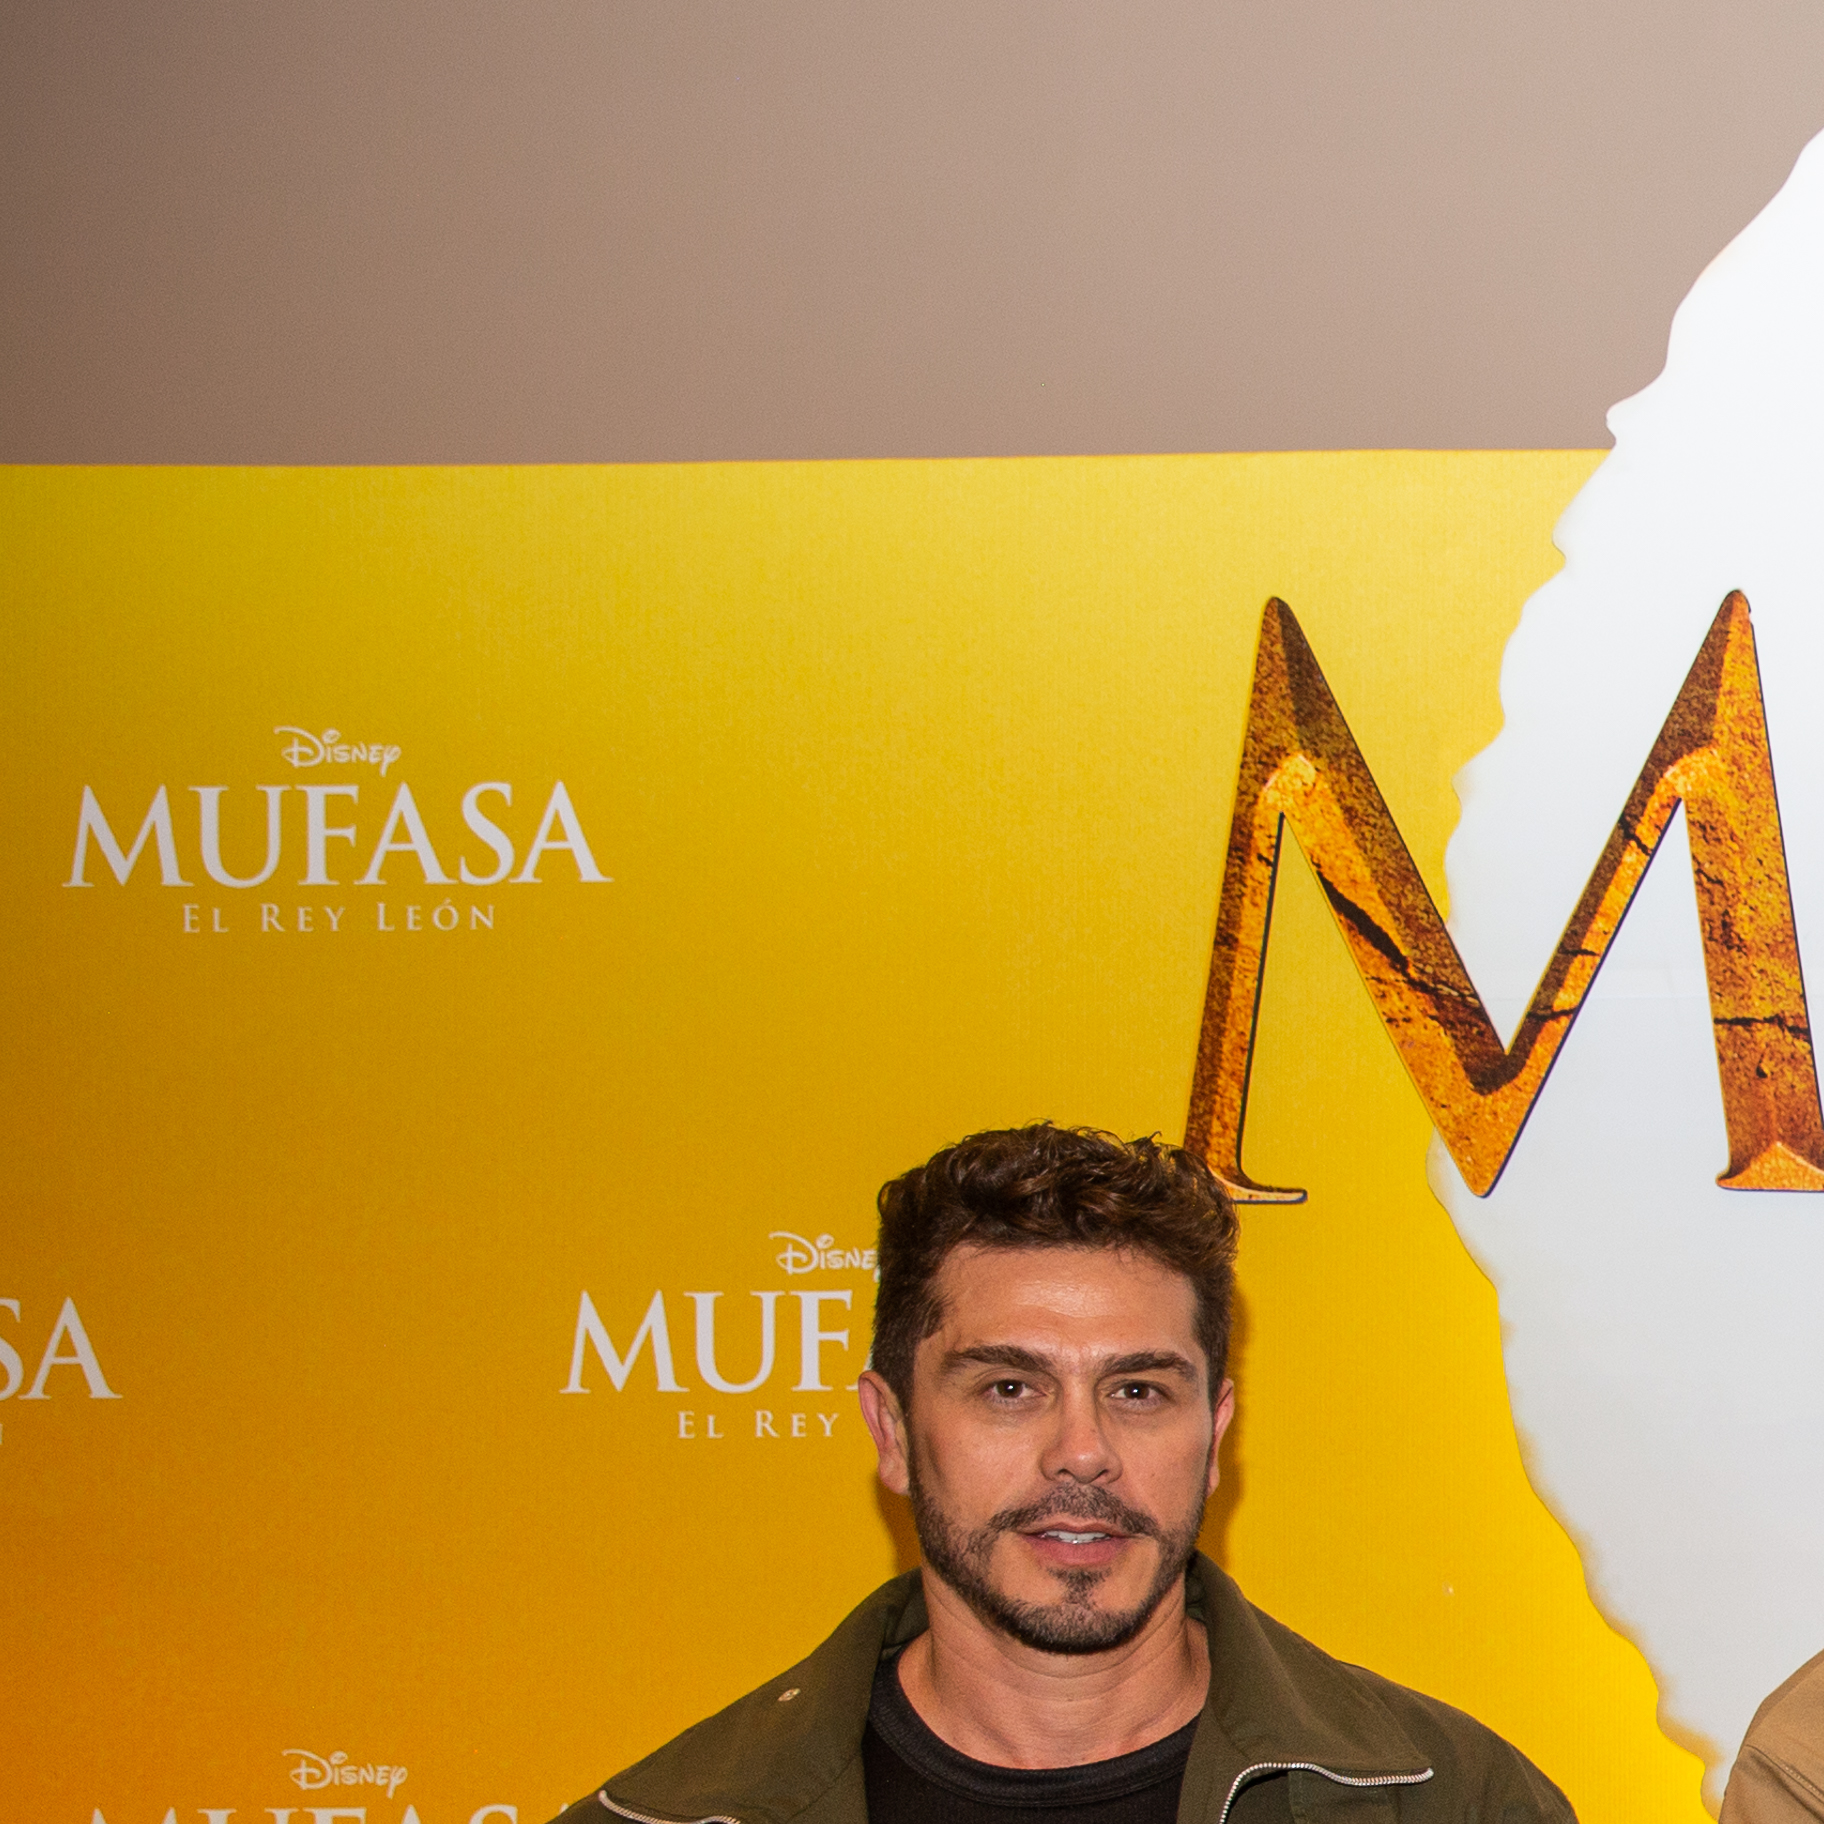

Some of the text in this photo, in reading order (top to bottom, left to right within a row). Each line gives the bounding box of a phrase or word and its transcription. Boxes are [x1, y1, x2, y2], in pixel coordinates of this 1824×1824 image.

[64, 781, 612, 888] MUFASA
[769, 1231, 882, 1282] Disne
[560, 1290, 872, 1393] MUF
